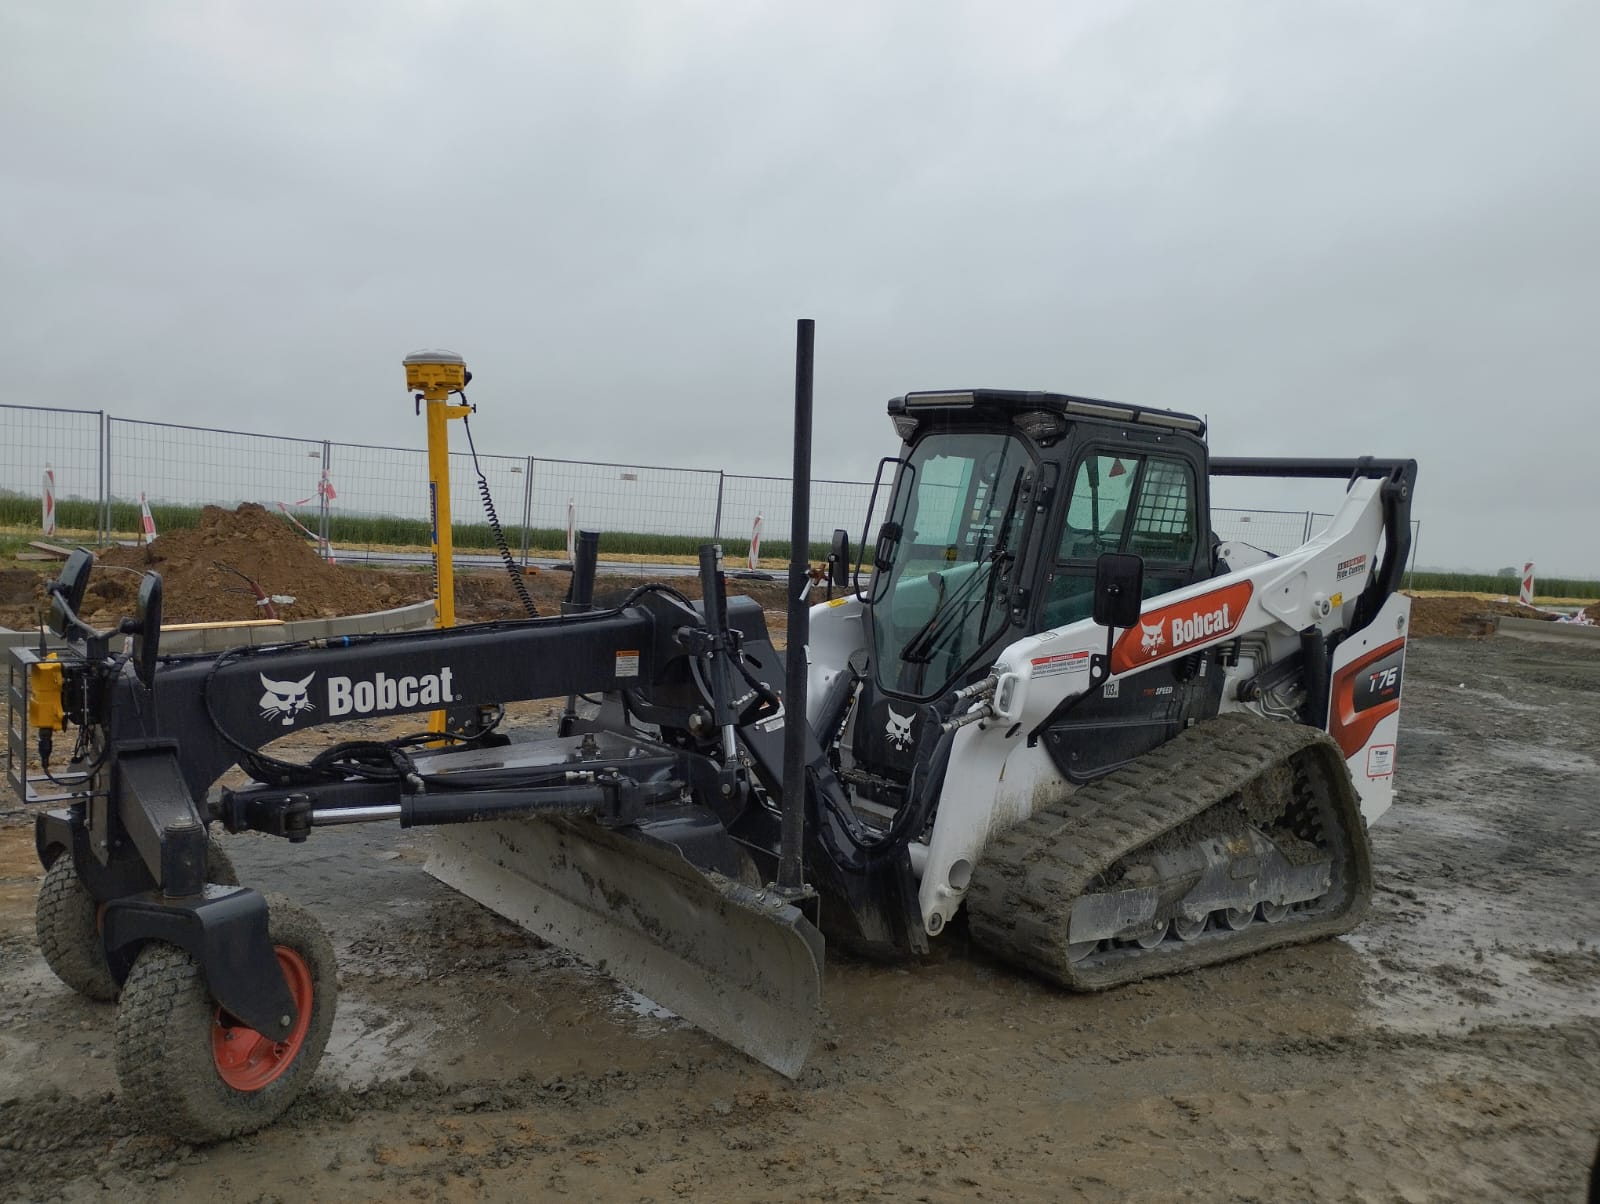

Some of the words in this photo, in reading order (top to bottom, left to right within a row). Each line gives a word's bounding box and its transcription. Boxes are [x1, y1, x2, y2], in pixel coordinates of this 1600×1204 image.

[1172, 603, 1229, 647] Bobcat
[328, 667, 454, 716] Bobcat
[1156, 686, 1173, 695] SPEED
[1370, 667, 1398, 692] T76
